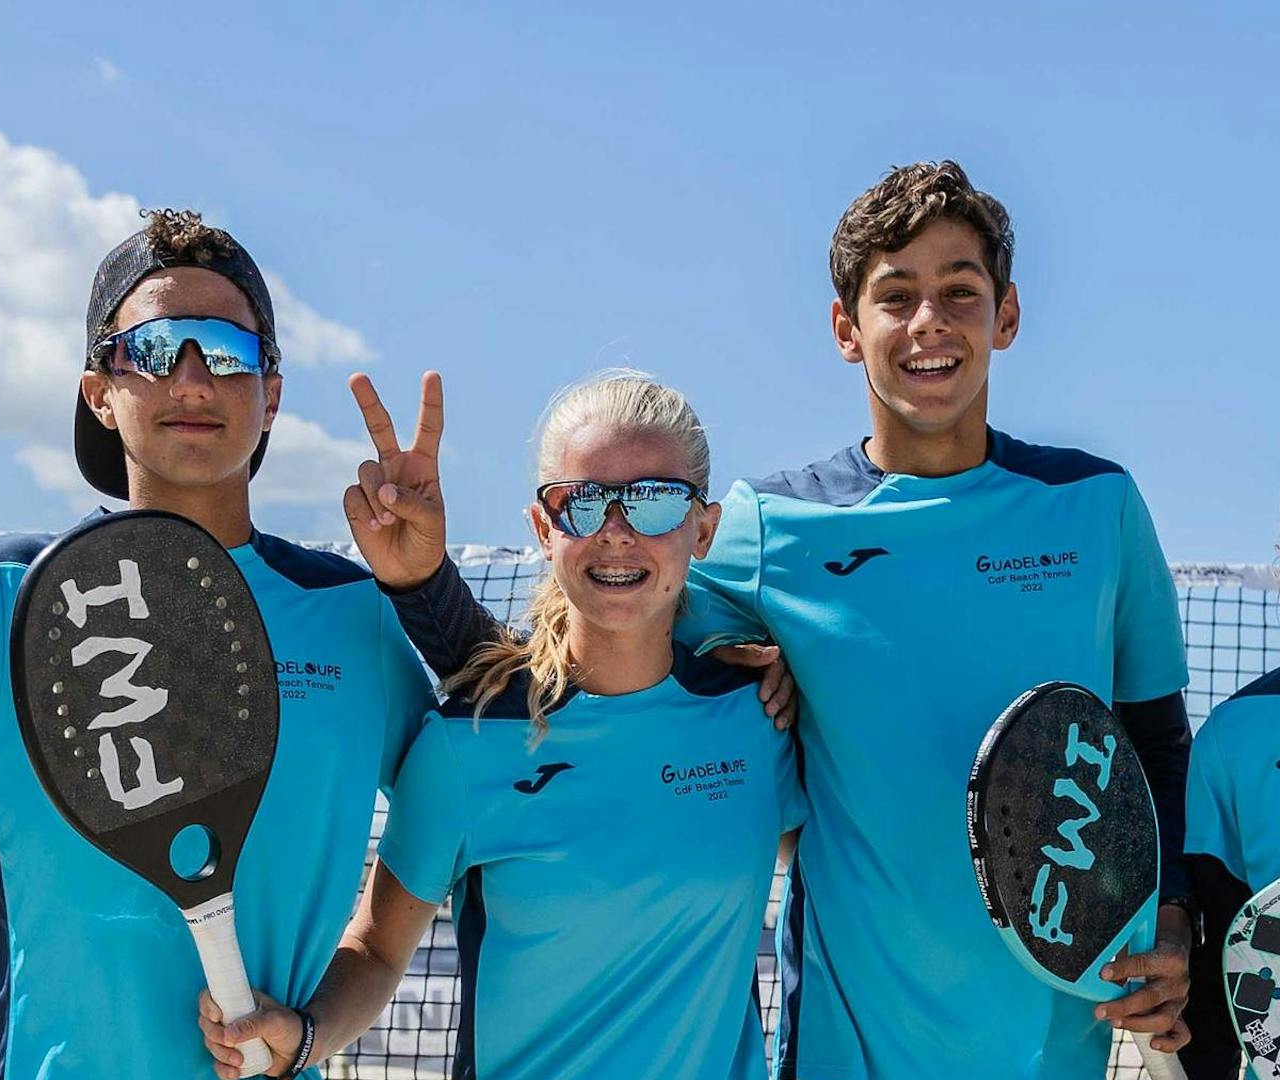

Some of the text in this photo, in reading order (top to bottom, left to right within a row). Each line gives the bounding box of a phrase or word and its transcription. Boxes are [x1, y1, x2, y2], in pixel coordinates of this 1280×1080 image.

[976, 552, 1078, 573] GUADELOUPE
[1010, 572, 1040, 583] Beach
[1041, 569, 1072, 580] Tennis
[1021, 583, 1043, 592] 2022
[60, 559, 184, 811] FWI
[305, 680, 336, 691] Tennis
[282, 689, 307, 699] 2022
[661, 759, 748, 784] GUADELOUPE
[696, 780, 723, 791] Beach
[708, 790, 728, 801] 2022
[1028, 722, 1117, 946] FWI
